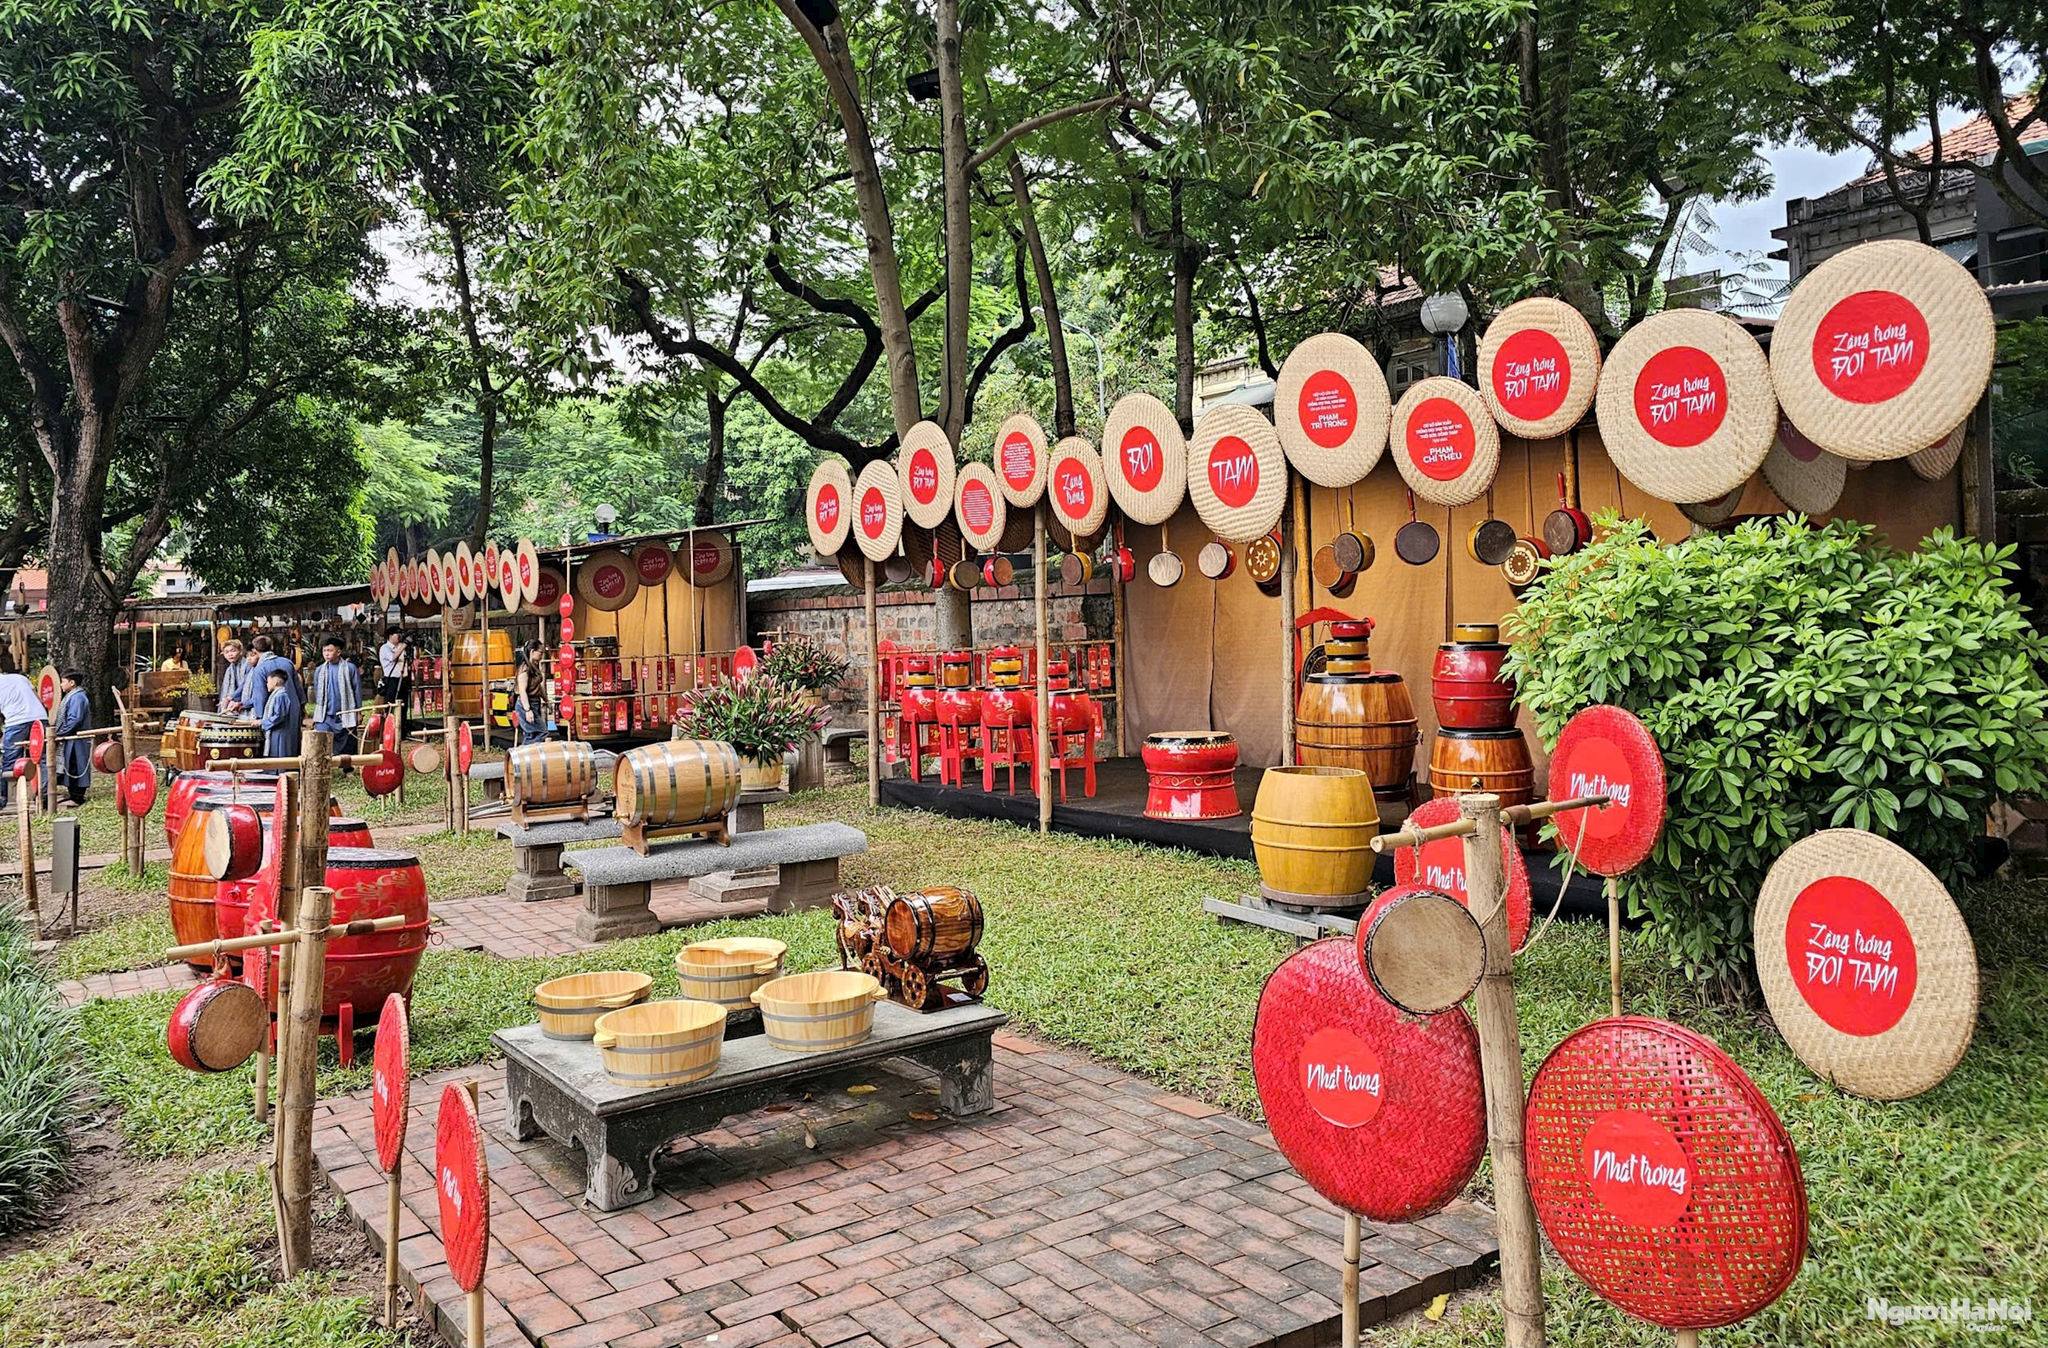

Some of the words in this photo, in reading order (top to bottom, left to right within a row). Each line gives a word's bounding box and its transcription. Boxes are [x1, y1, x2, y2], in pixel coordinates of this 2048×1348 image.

[1869, 340, 1914, 370] TAM
[1530, 372, 1560, 393] TAM
[1680, 391, 1715, 418] TAM
[1212, 454, 1254, 491] TAM
[1848, 958, 1898, 999] TAM
